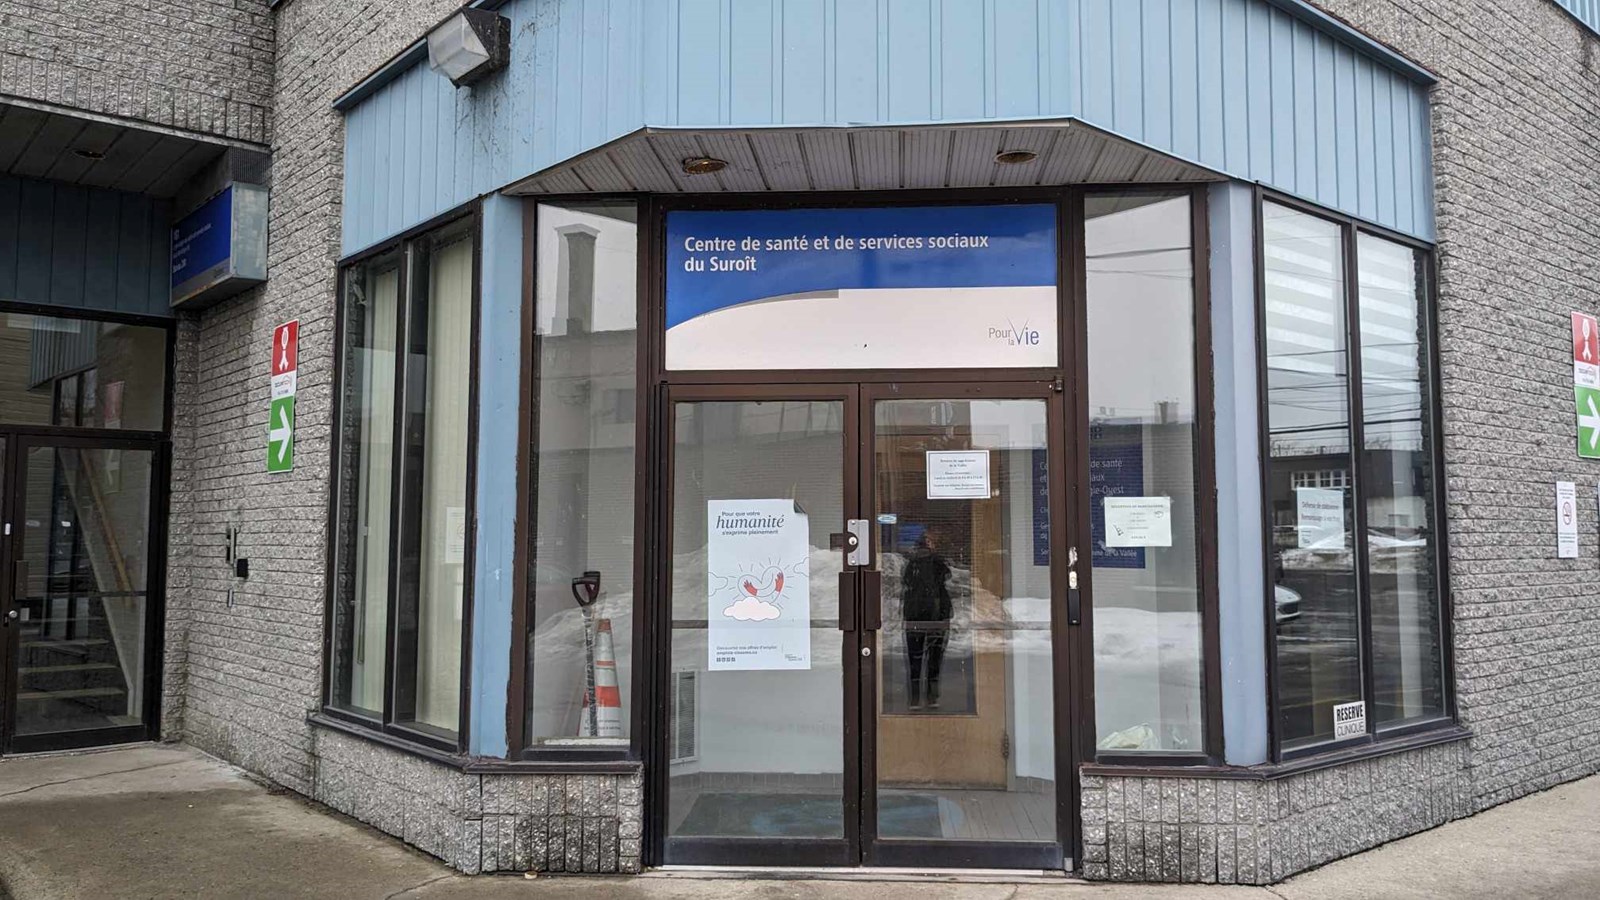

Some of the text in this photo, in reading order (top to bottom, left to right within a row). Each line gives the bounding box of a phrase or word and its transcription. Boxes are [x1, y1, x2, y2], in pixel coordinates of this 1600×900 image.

[684, 233, 989, 251] Centre de santé et de services sociaux
[684, 256, 757, 272] du Suroît
[988, 327, 1011, 338] Pour
[1007, 317, 1040, 345] Vie
[716, 514, 785, 529] humanité
[1336, 721, 1365, 737] CLINIQUE
